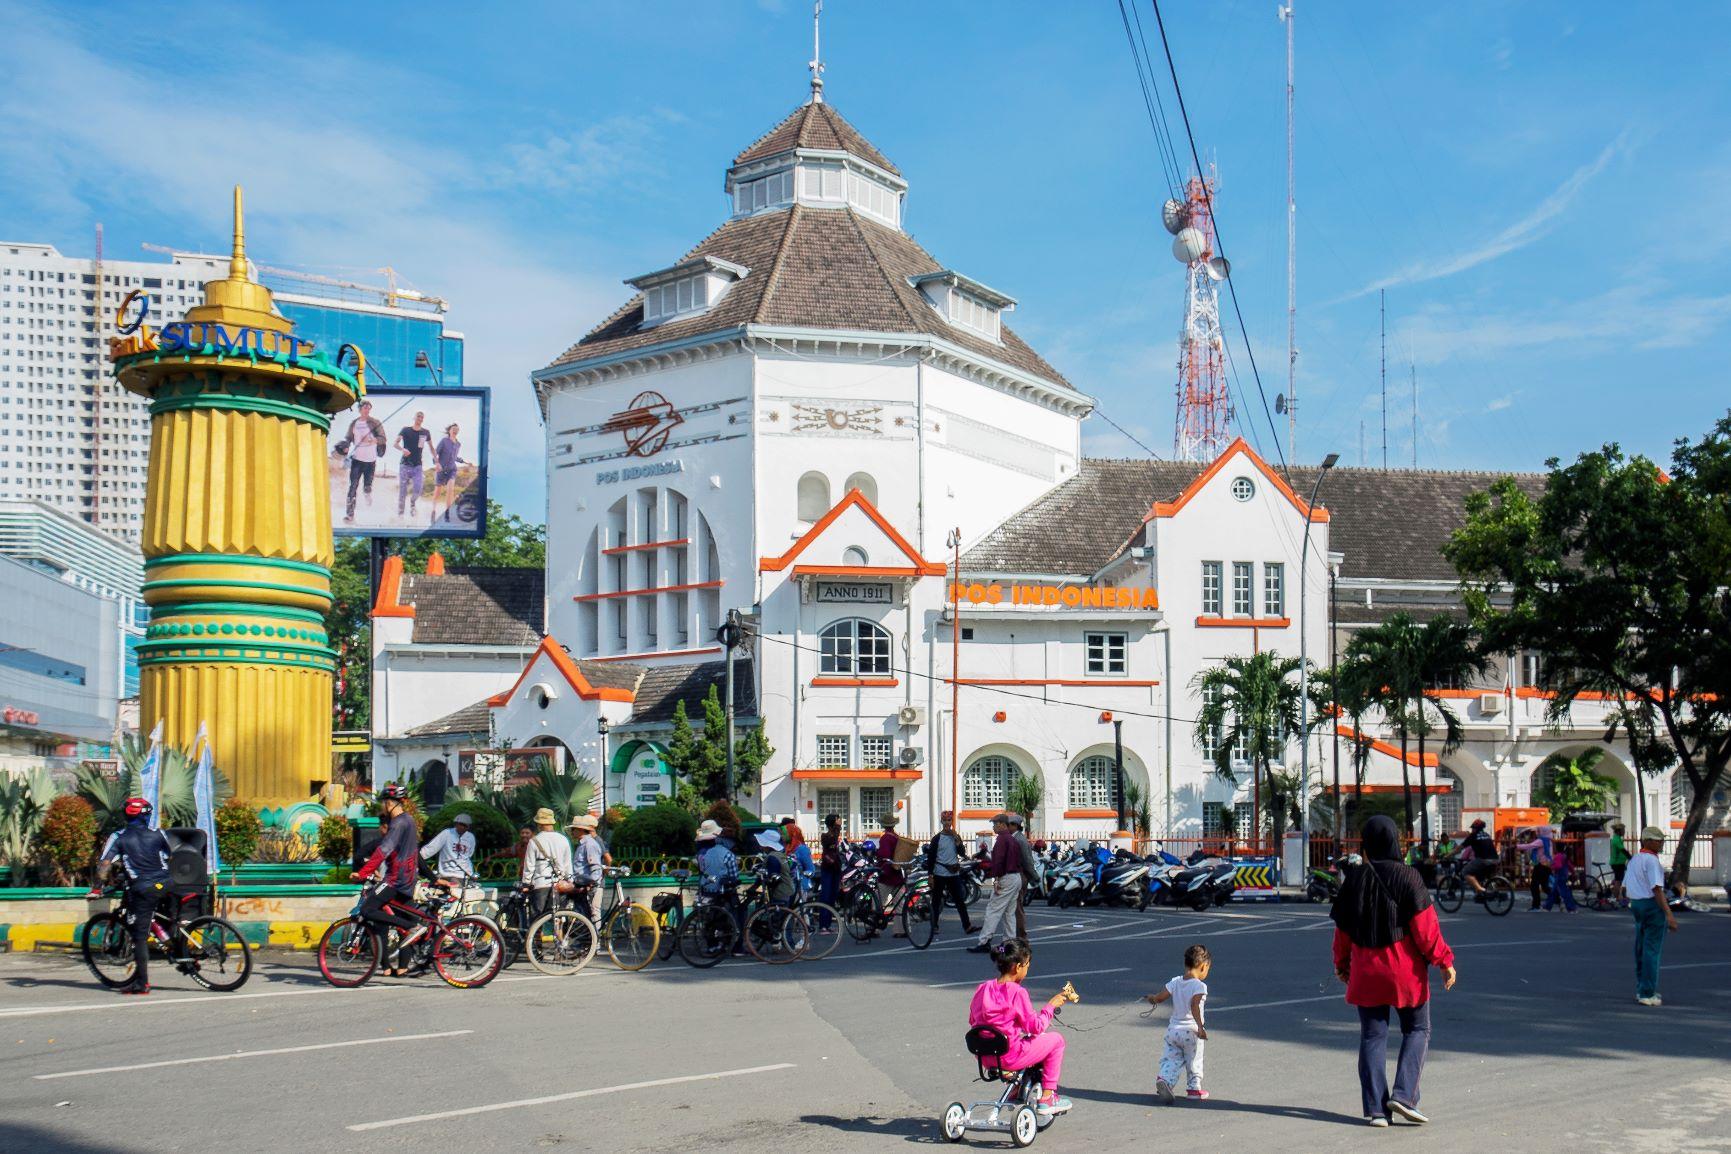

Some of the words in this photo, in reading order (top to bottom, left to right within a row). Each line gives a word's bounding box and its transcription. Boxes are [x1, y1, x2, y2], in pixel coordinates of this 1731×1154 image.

[160, 320, 307, 364] SUMUT
[596, 470, 620, 486] POS
[622, 459, 685, 481] INDONESIA
[824, 587, 858, 598] ANNO
[863, 587, 883, 599] 1911
[949, 583, 1004, 604] POS
[1012, 584, 1159, 609] INDONESIA
